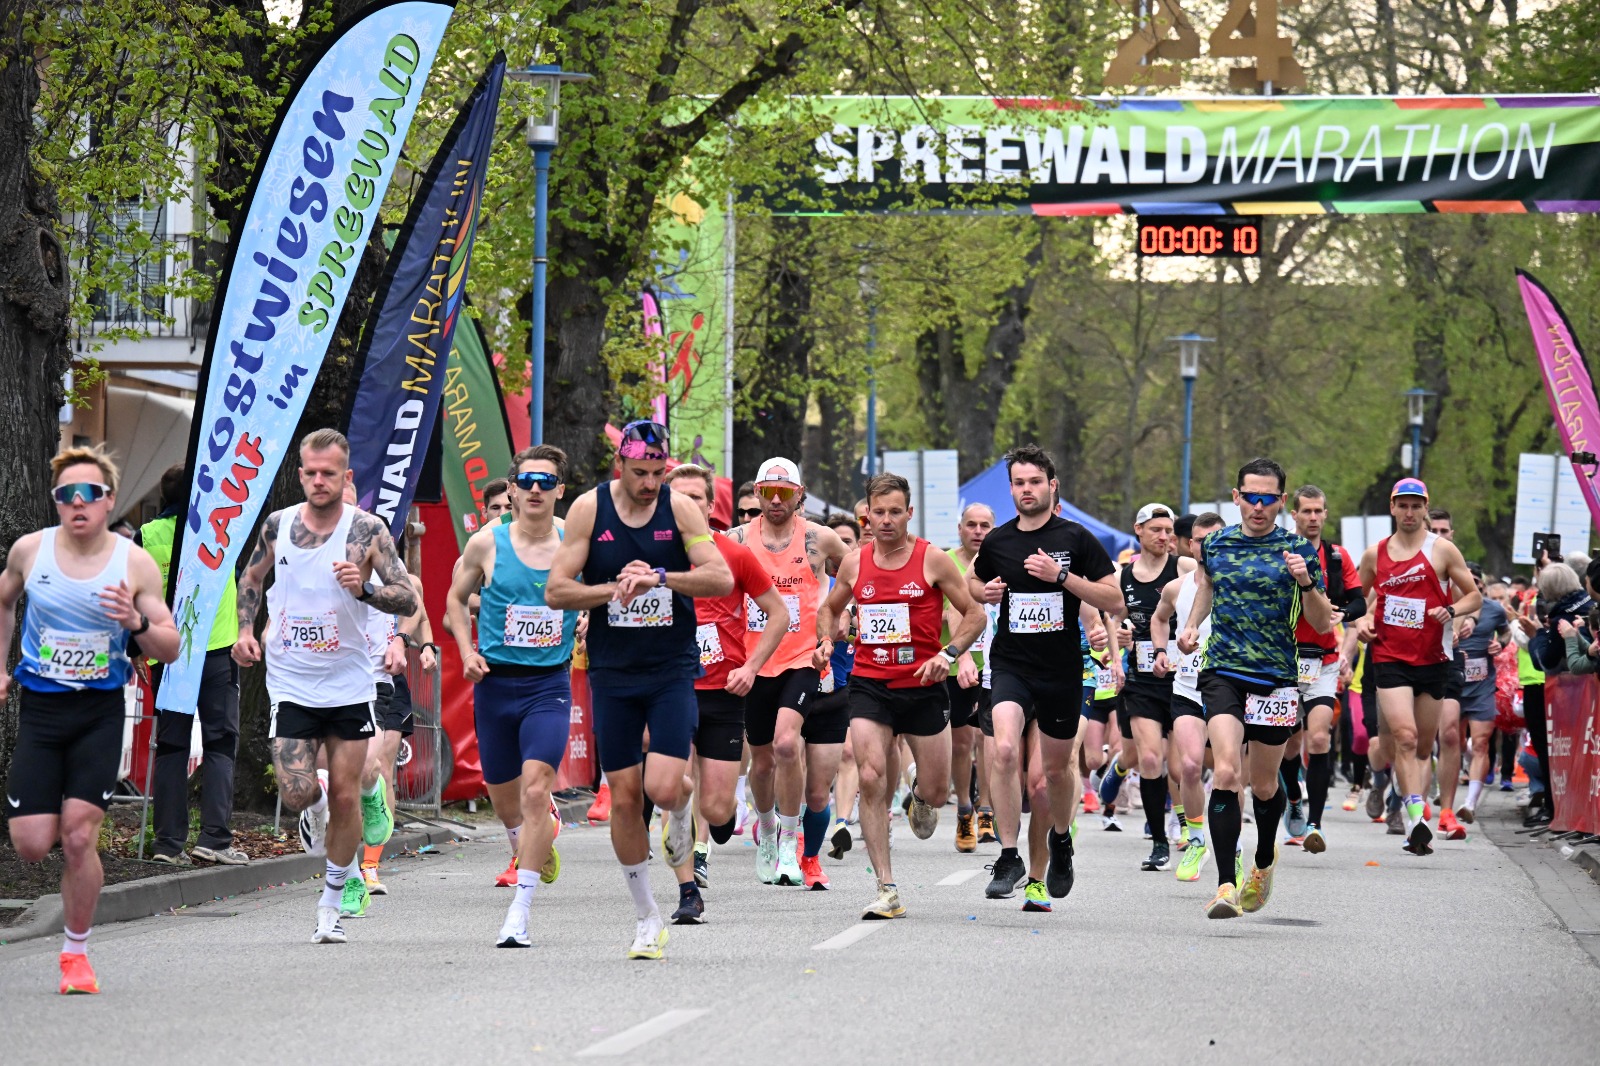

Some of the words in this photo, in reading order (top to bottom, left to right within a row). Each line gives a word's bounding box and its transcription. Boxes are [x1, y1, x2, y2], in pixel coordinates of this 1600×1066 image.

[813, 124, 1208, 185] SPREEWALD
[1212, 122, 1556, 185] MARATHON
[266, 364, 309, 410] im
[298, 33, 421, 335] SPREEWALD
[1018, 607, 1051, 622] 4461
[1390, 606, 1417, 620] 4478
[291, 626, 325, 642] 7851
[516, 620, 553, 637] 7045
[870, 618, 897, 634] 324
[51, 648, 96, 667] 4222
[1256, 700, 1290, 715] 7635
